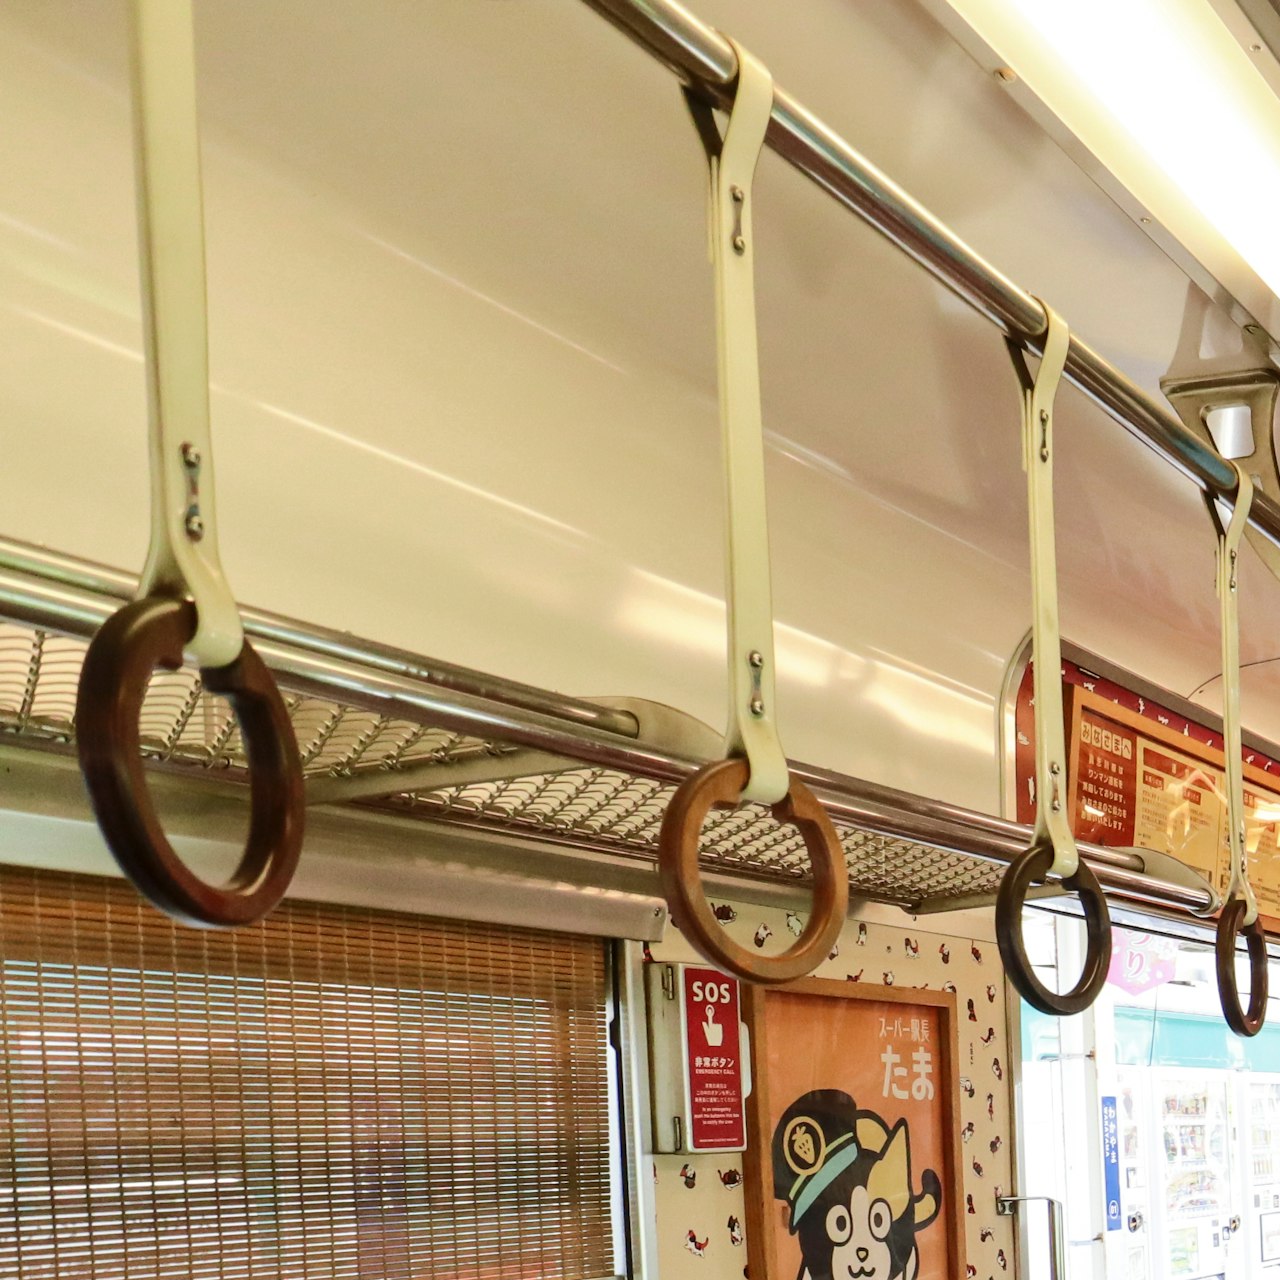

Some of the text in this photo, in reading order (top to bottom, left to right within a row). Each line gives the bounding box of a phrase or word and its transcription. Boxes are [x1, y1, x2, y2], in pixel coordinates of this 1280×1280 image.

[1082, 723, 1131, 757] みなさまへ
[692, 980, 731, 1004] SOS
[879, 1016, 930, 1042] スーパー駅長
[695, 1056, 735, 1068] 非常ボタン
[880, 1044, 935, 1101] たま
[1108, 1106, 1118, 1164] わかやま
